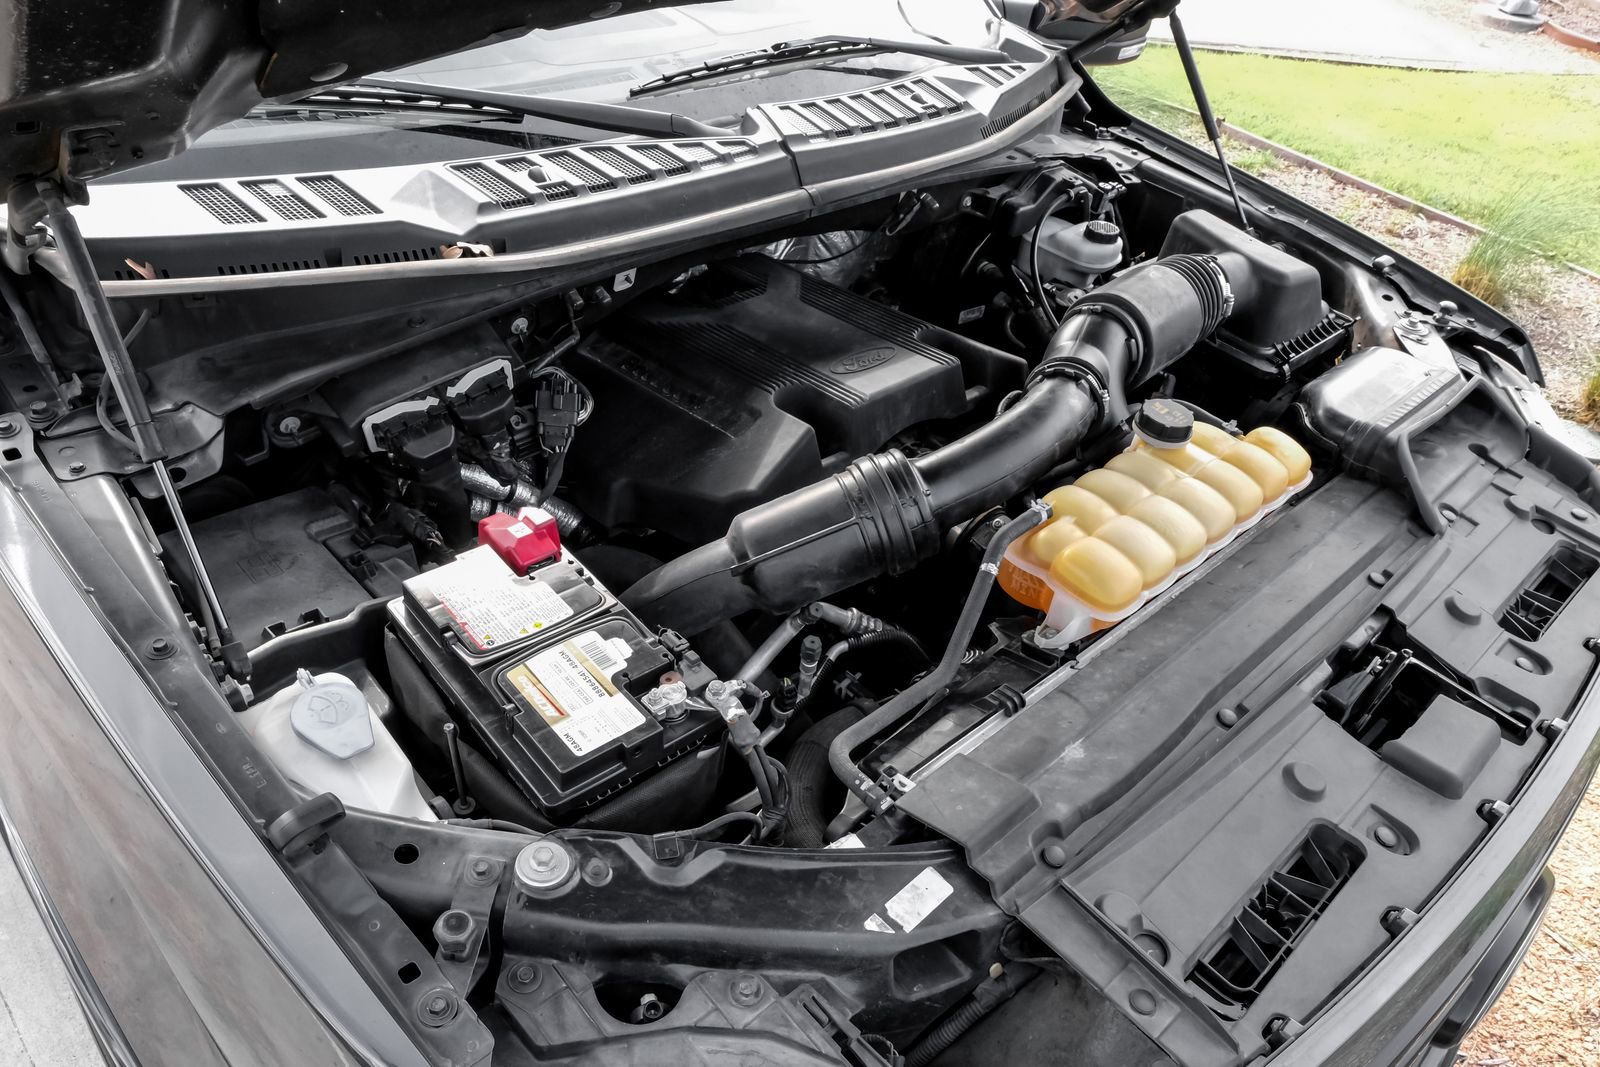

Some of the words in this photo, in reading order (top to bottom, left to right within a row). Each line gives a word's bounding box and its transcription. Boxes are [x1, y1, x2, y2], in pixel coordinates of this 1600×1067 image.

[842, 351, 885, 371] Ford
[559, 651, 578, 669] 48AGM
[577, 671, 606, 698] 88864541
[563, 733, 583, 752] 48AGM
